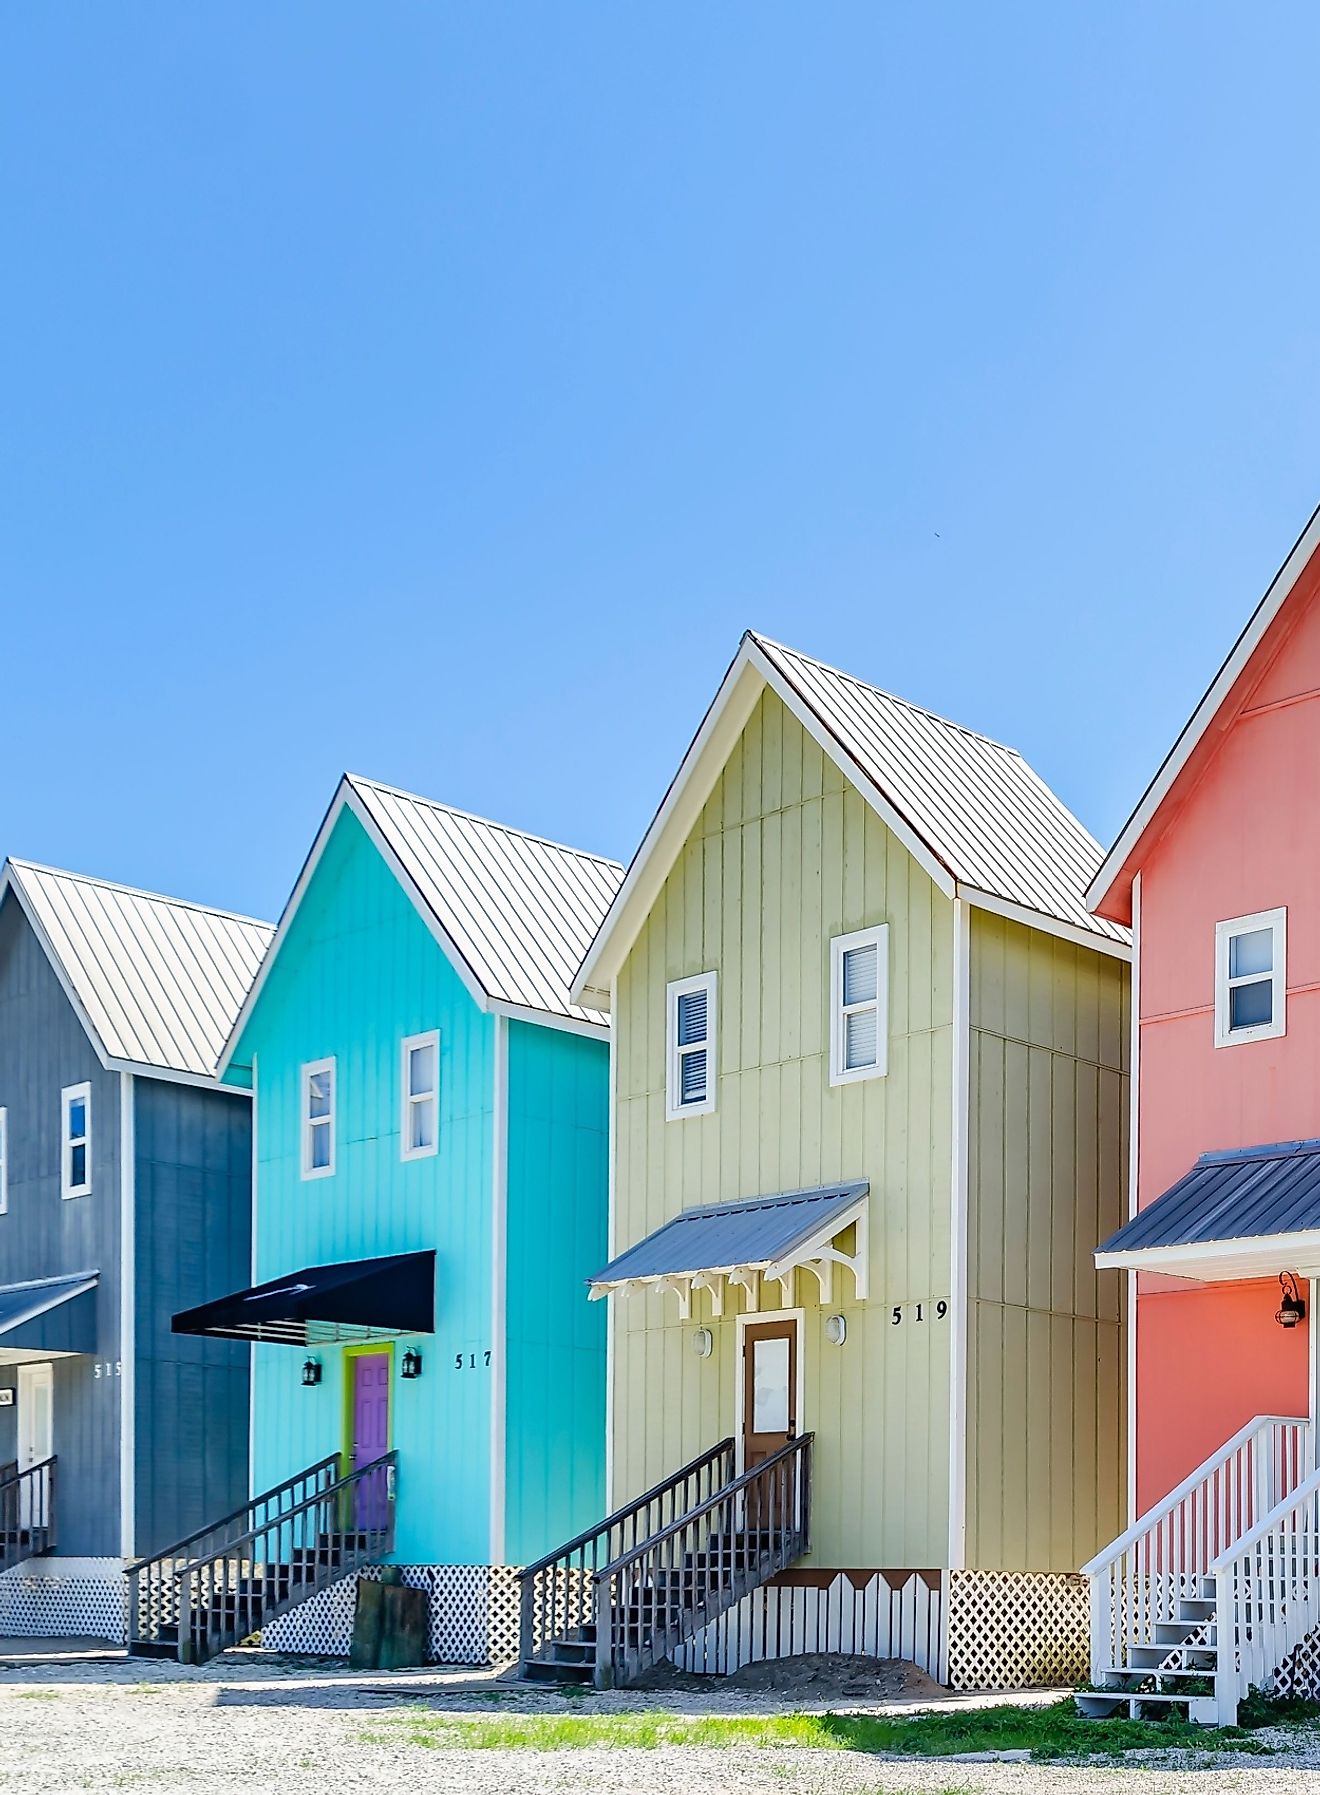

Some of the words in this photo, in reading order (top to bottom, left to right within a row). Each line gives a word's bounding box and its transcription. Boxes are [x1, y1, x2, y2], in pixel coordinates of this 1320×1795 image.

[891, 1300, 948, 1325] 519
[94, 1361, 121, 1379] 515
[454, 1350, 492, 1370] 517
